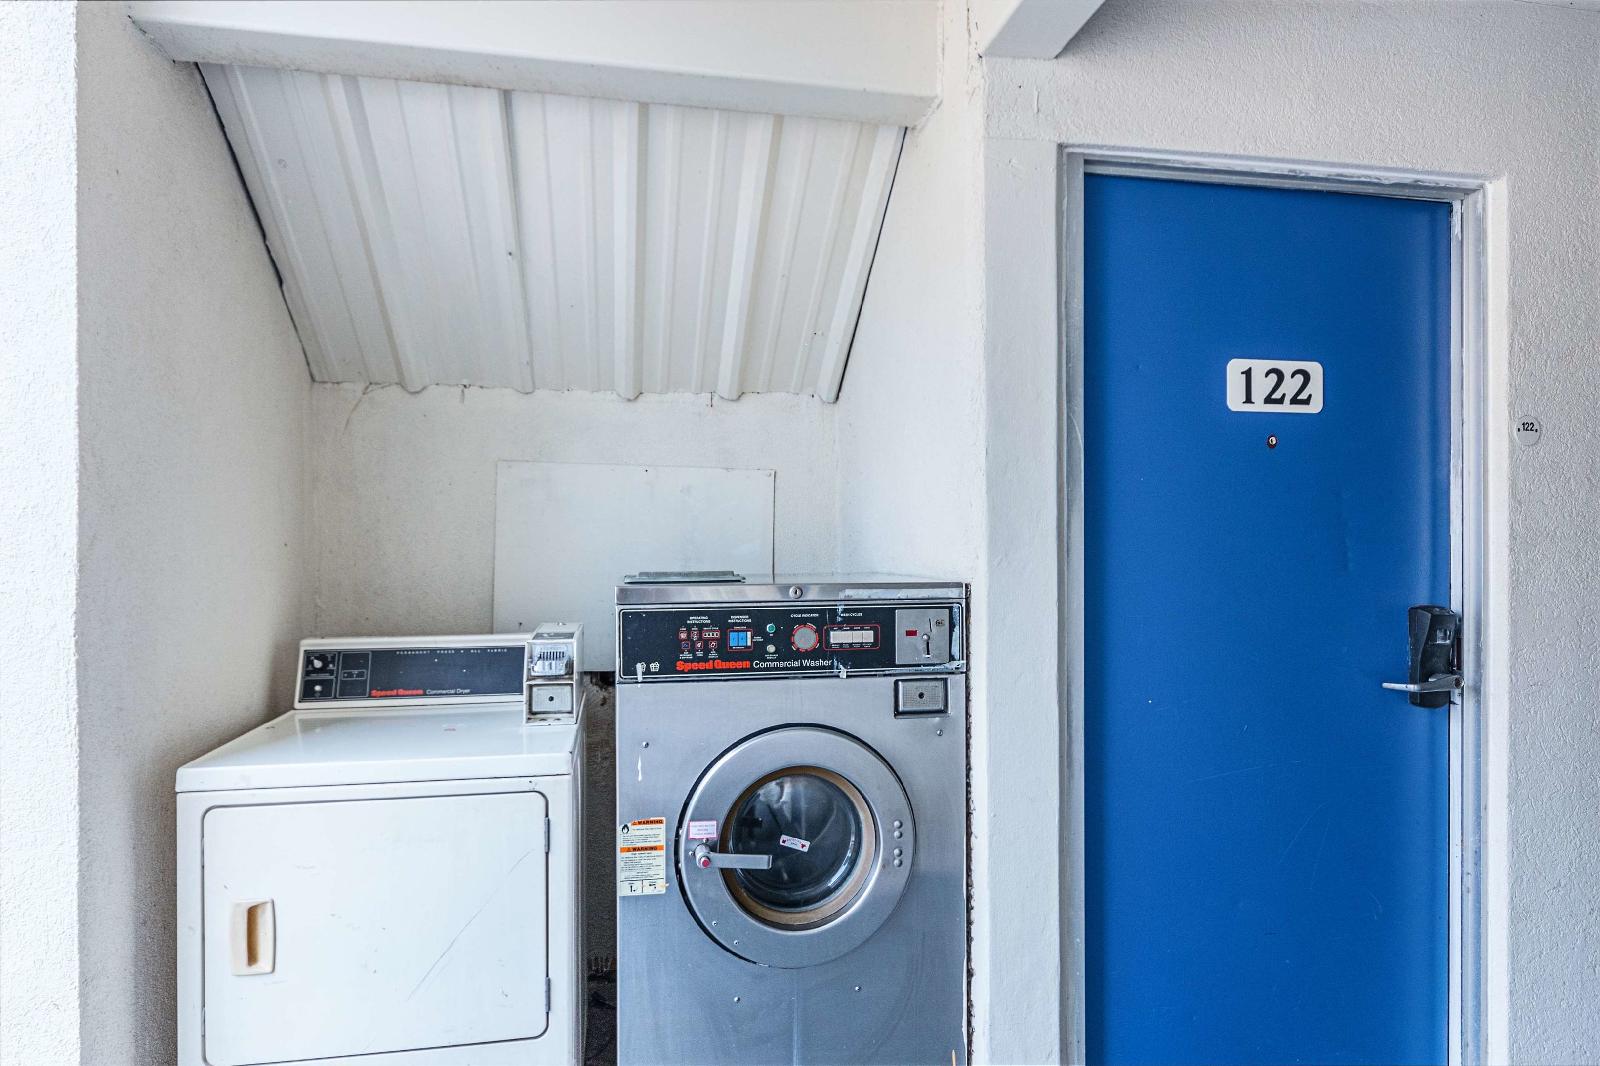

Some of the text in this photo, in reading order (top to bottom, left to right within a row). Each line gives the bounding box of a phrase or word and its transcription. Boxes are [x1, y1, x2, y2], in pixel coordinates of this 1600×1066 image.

[1240, 366, 1313, 406] 122
[1521, 421, 1535, 432] 122
[676, 659, 832, 672] Speed Queen Commercial Washer
[371, 689, 397, 697] Speed
